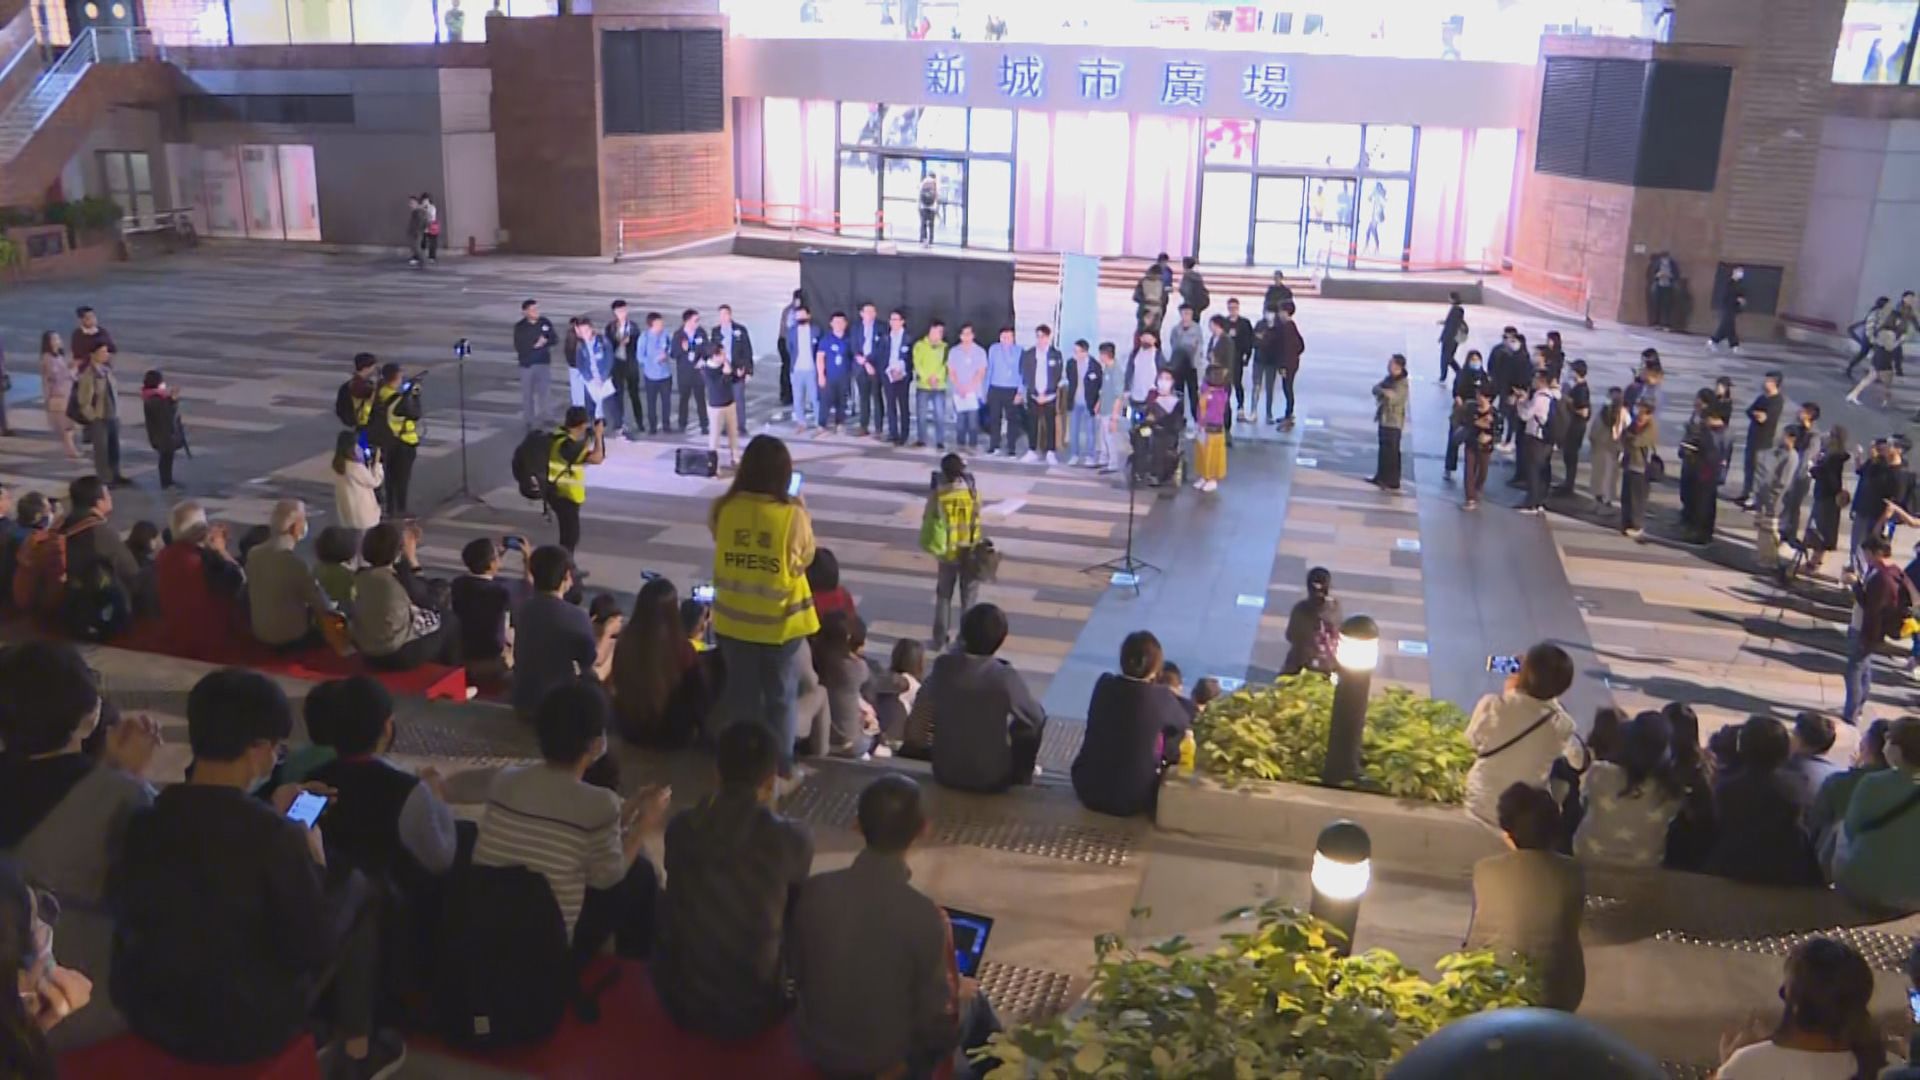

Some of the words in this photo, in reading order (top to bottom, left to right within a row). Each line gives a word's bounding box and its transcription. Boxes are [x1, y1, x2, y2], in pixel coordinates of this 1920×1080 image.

[925, 51, 1292, 110] 新城市廣場
[724, 551, 780, 574] PRESS
